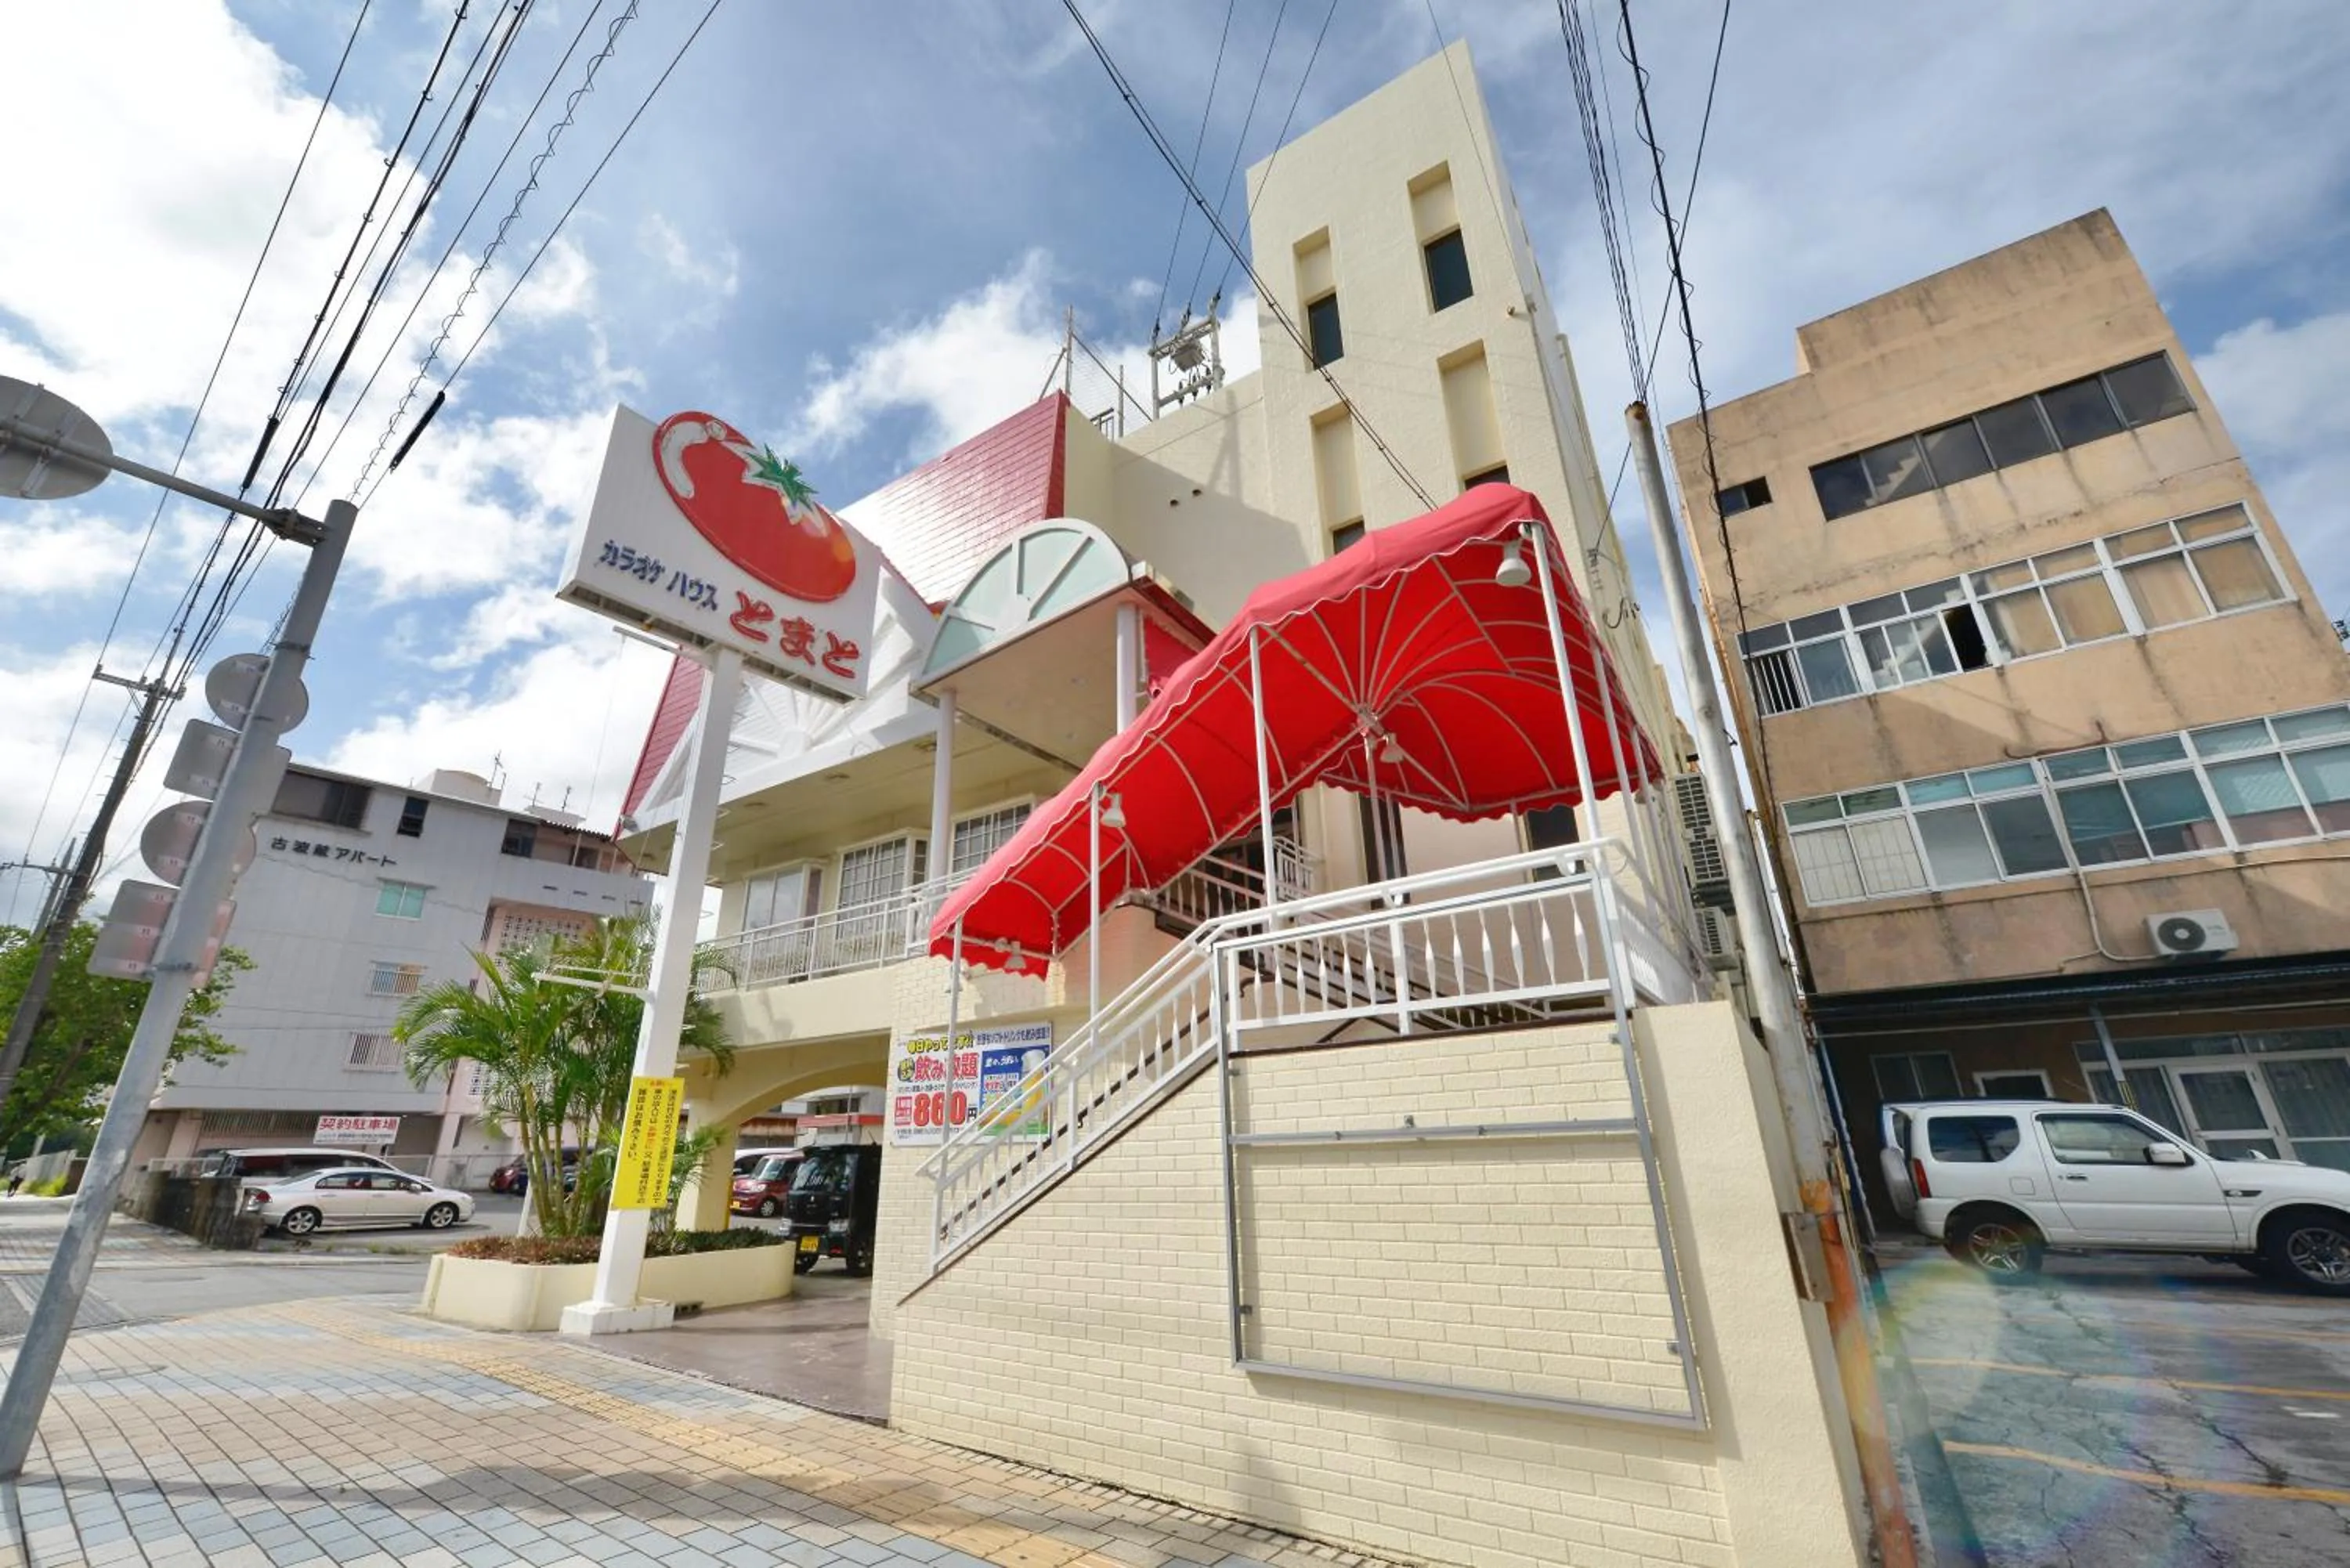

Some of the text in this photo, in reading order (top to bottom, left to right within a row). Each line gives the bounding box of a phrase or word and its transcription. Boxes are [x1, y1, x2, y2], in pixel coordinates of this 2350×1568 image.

[598, 540, 718, 612] カラオケ ハウス
[729, 591, 859, 679] とまと
